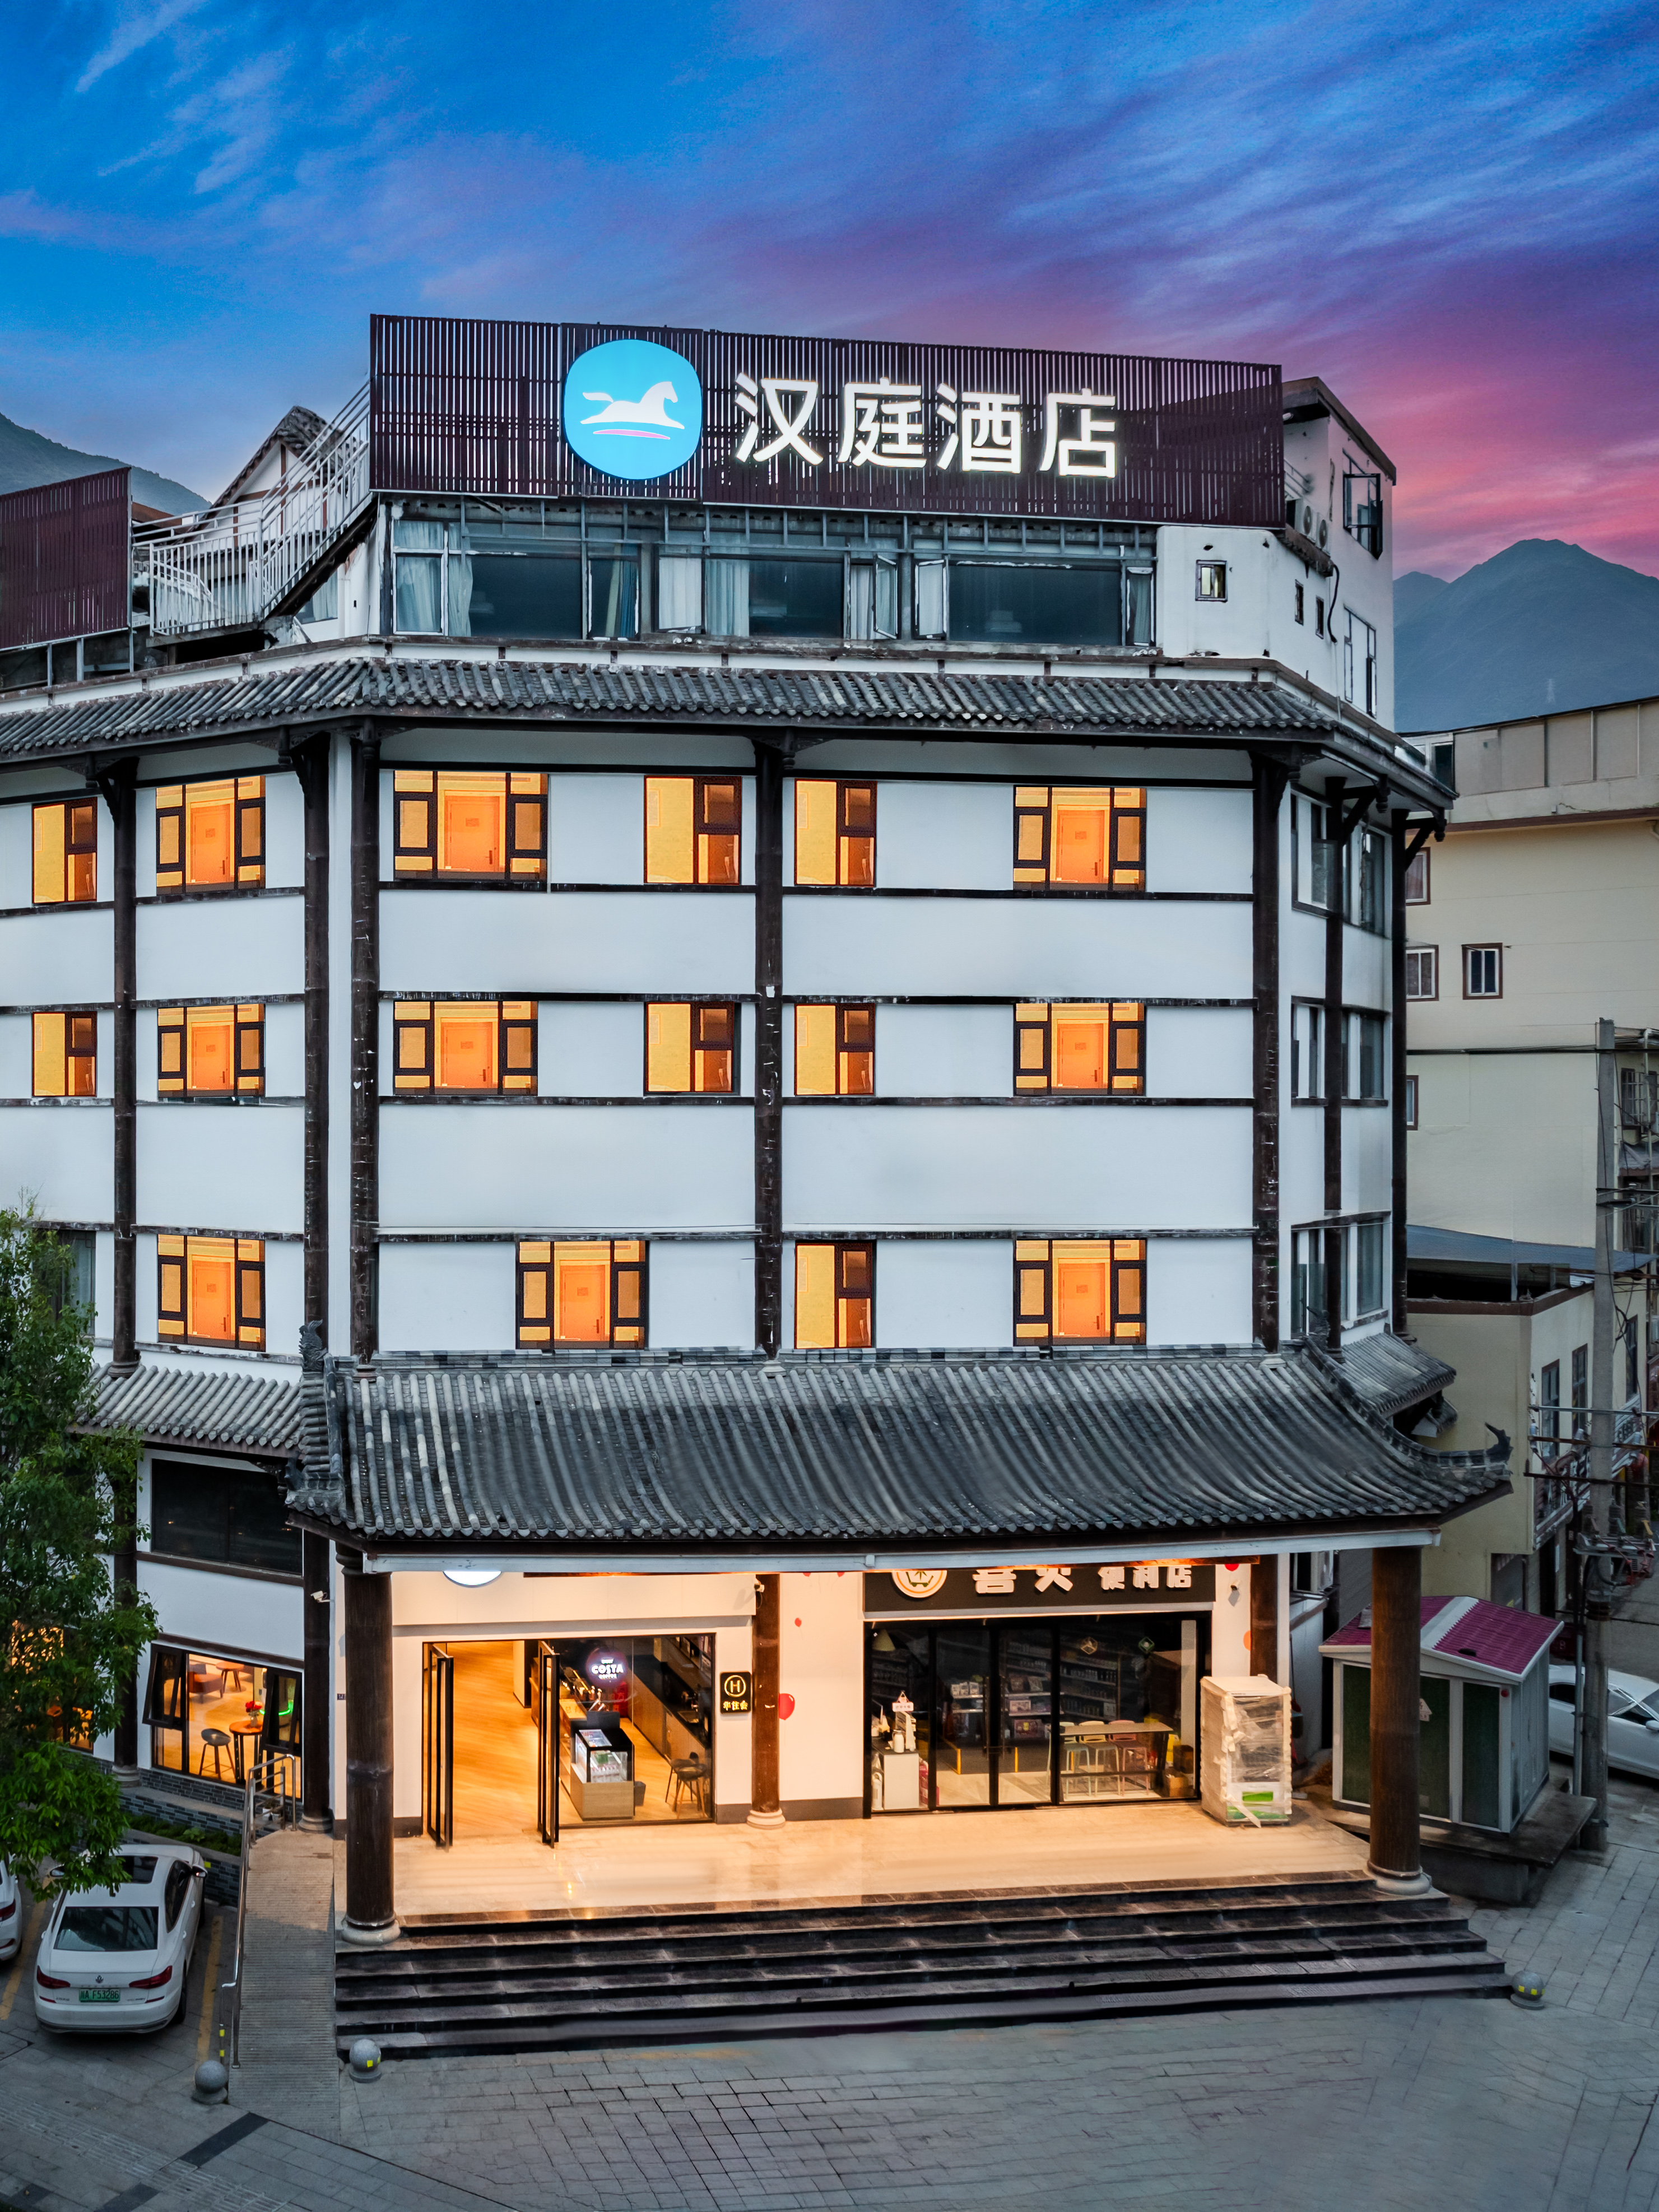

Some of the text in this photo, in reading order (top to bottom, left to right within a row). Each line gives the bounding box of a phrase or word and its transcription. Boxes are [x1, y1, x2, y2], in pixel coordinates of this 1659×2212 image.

[735, 372, 1116, 478] 汉庭酒店
[591, 1664, 624, 1674] COSTA
[723, 1700, 748, 1711] 华住会
